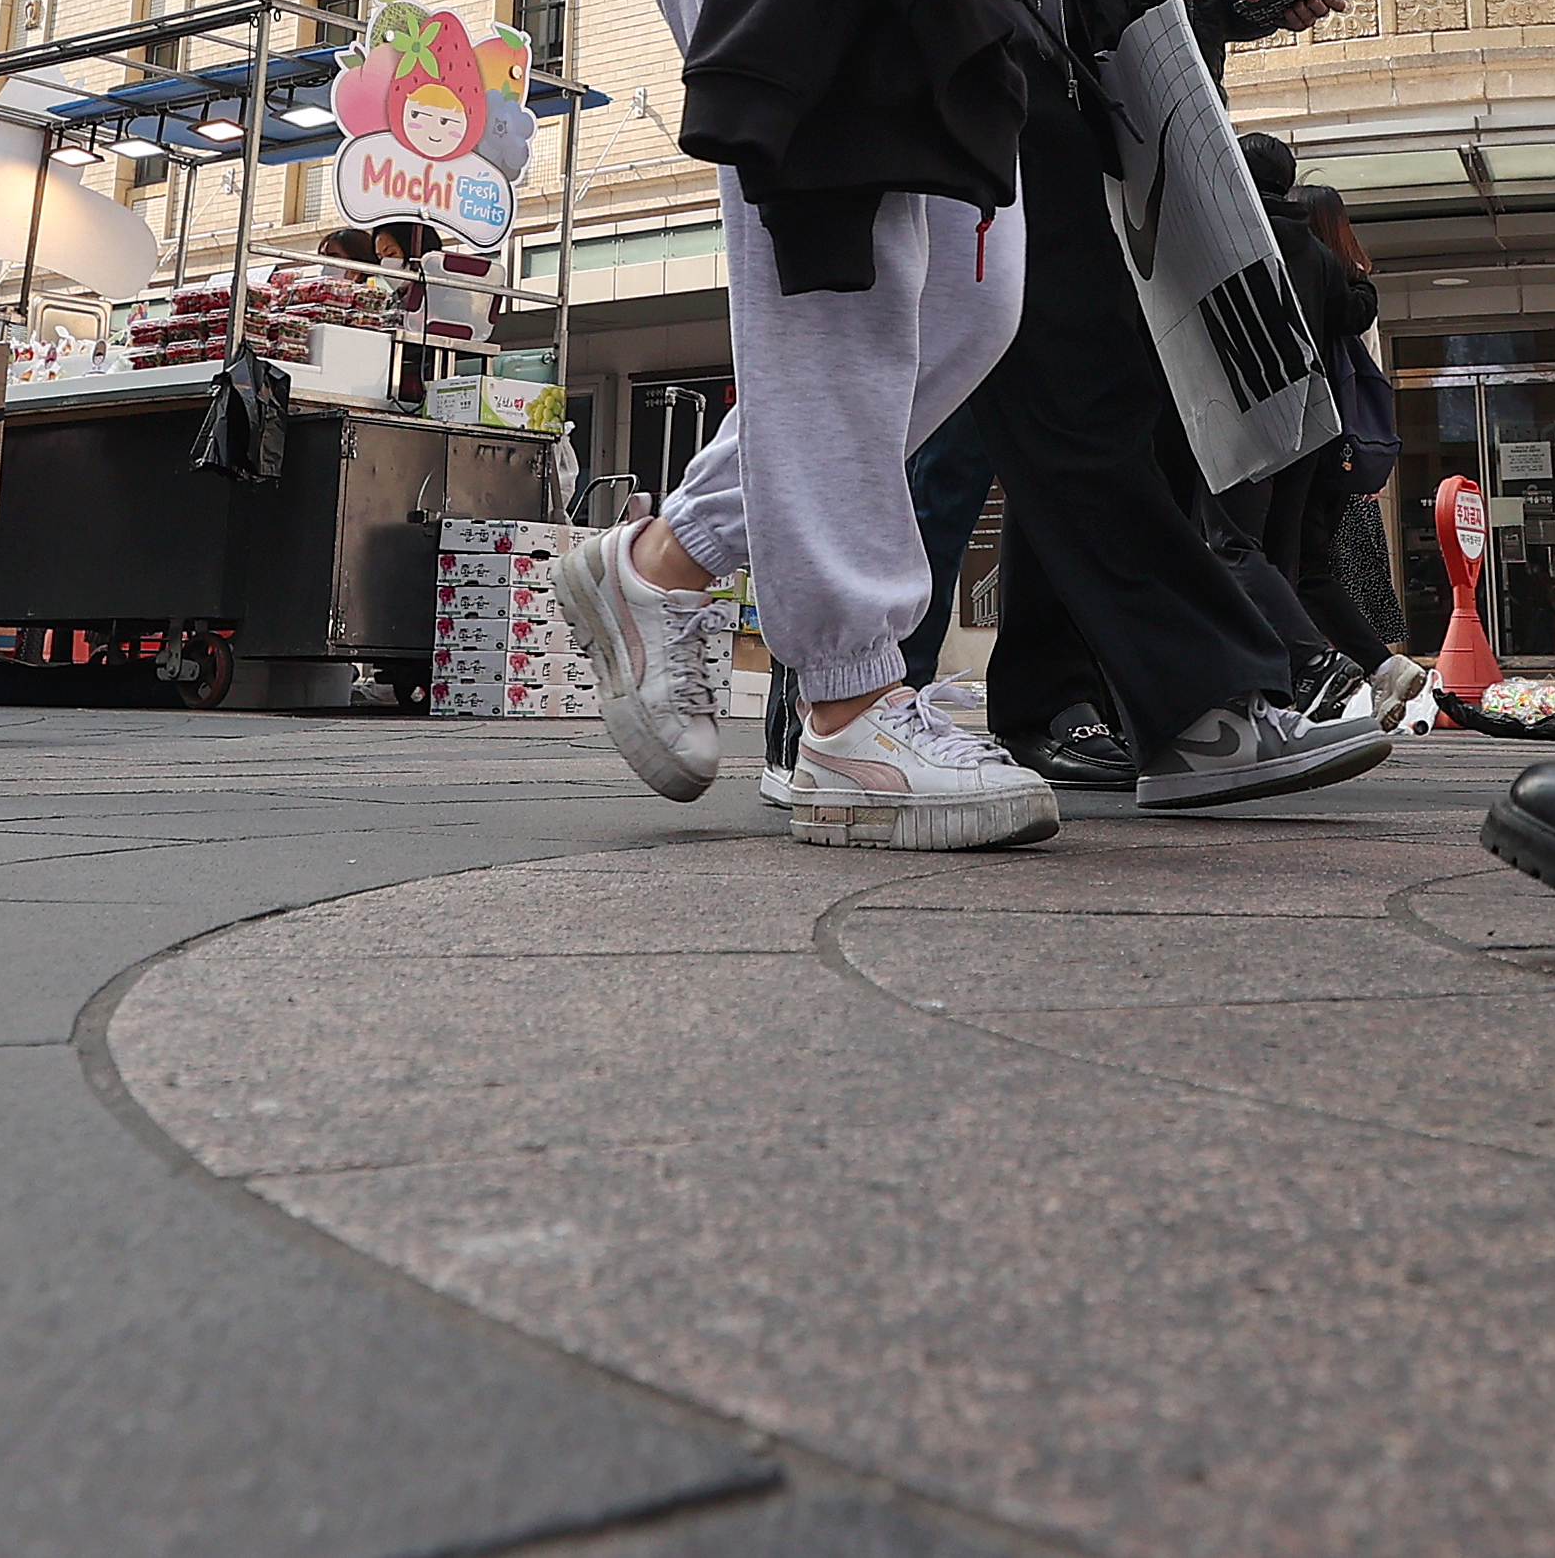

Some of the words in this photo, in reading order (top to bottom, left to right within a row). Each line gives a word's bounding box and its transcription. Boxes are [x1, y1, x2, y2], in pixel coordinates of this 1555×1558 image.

[363, 154, 453, 210] Mochi
[458, 178, 498, 202] Fresh
[463, 200, 505, 223] Fruits
